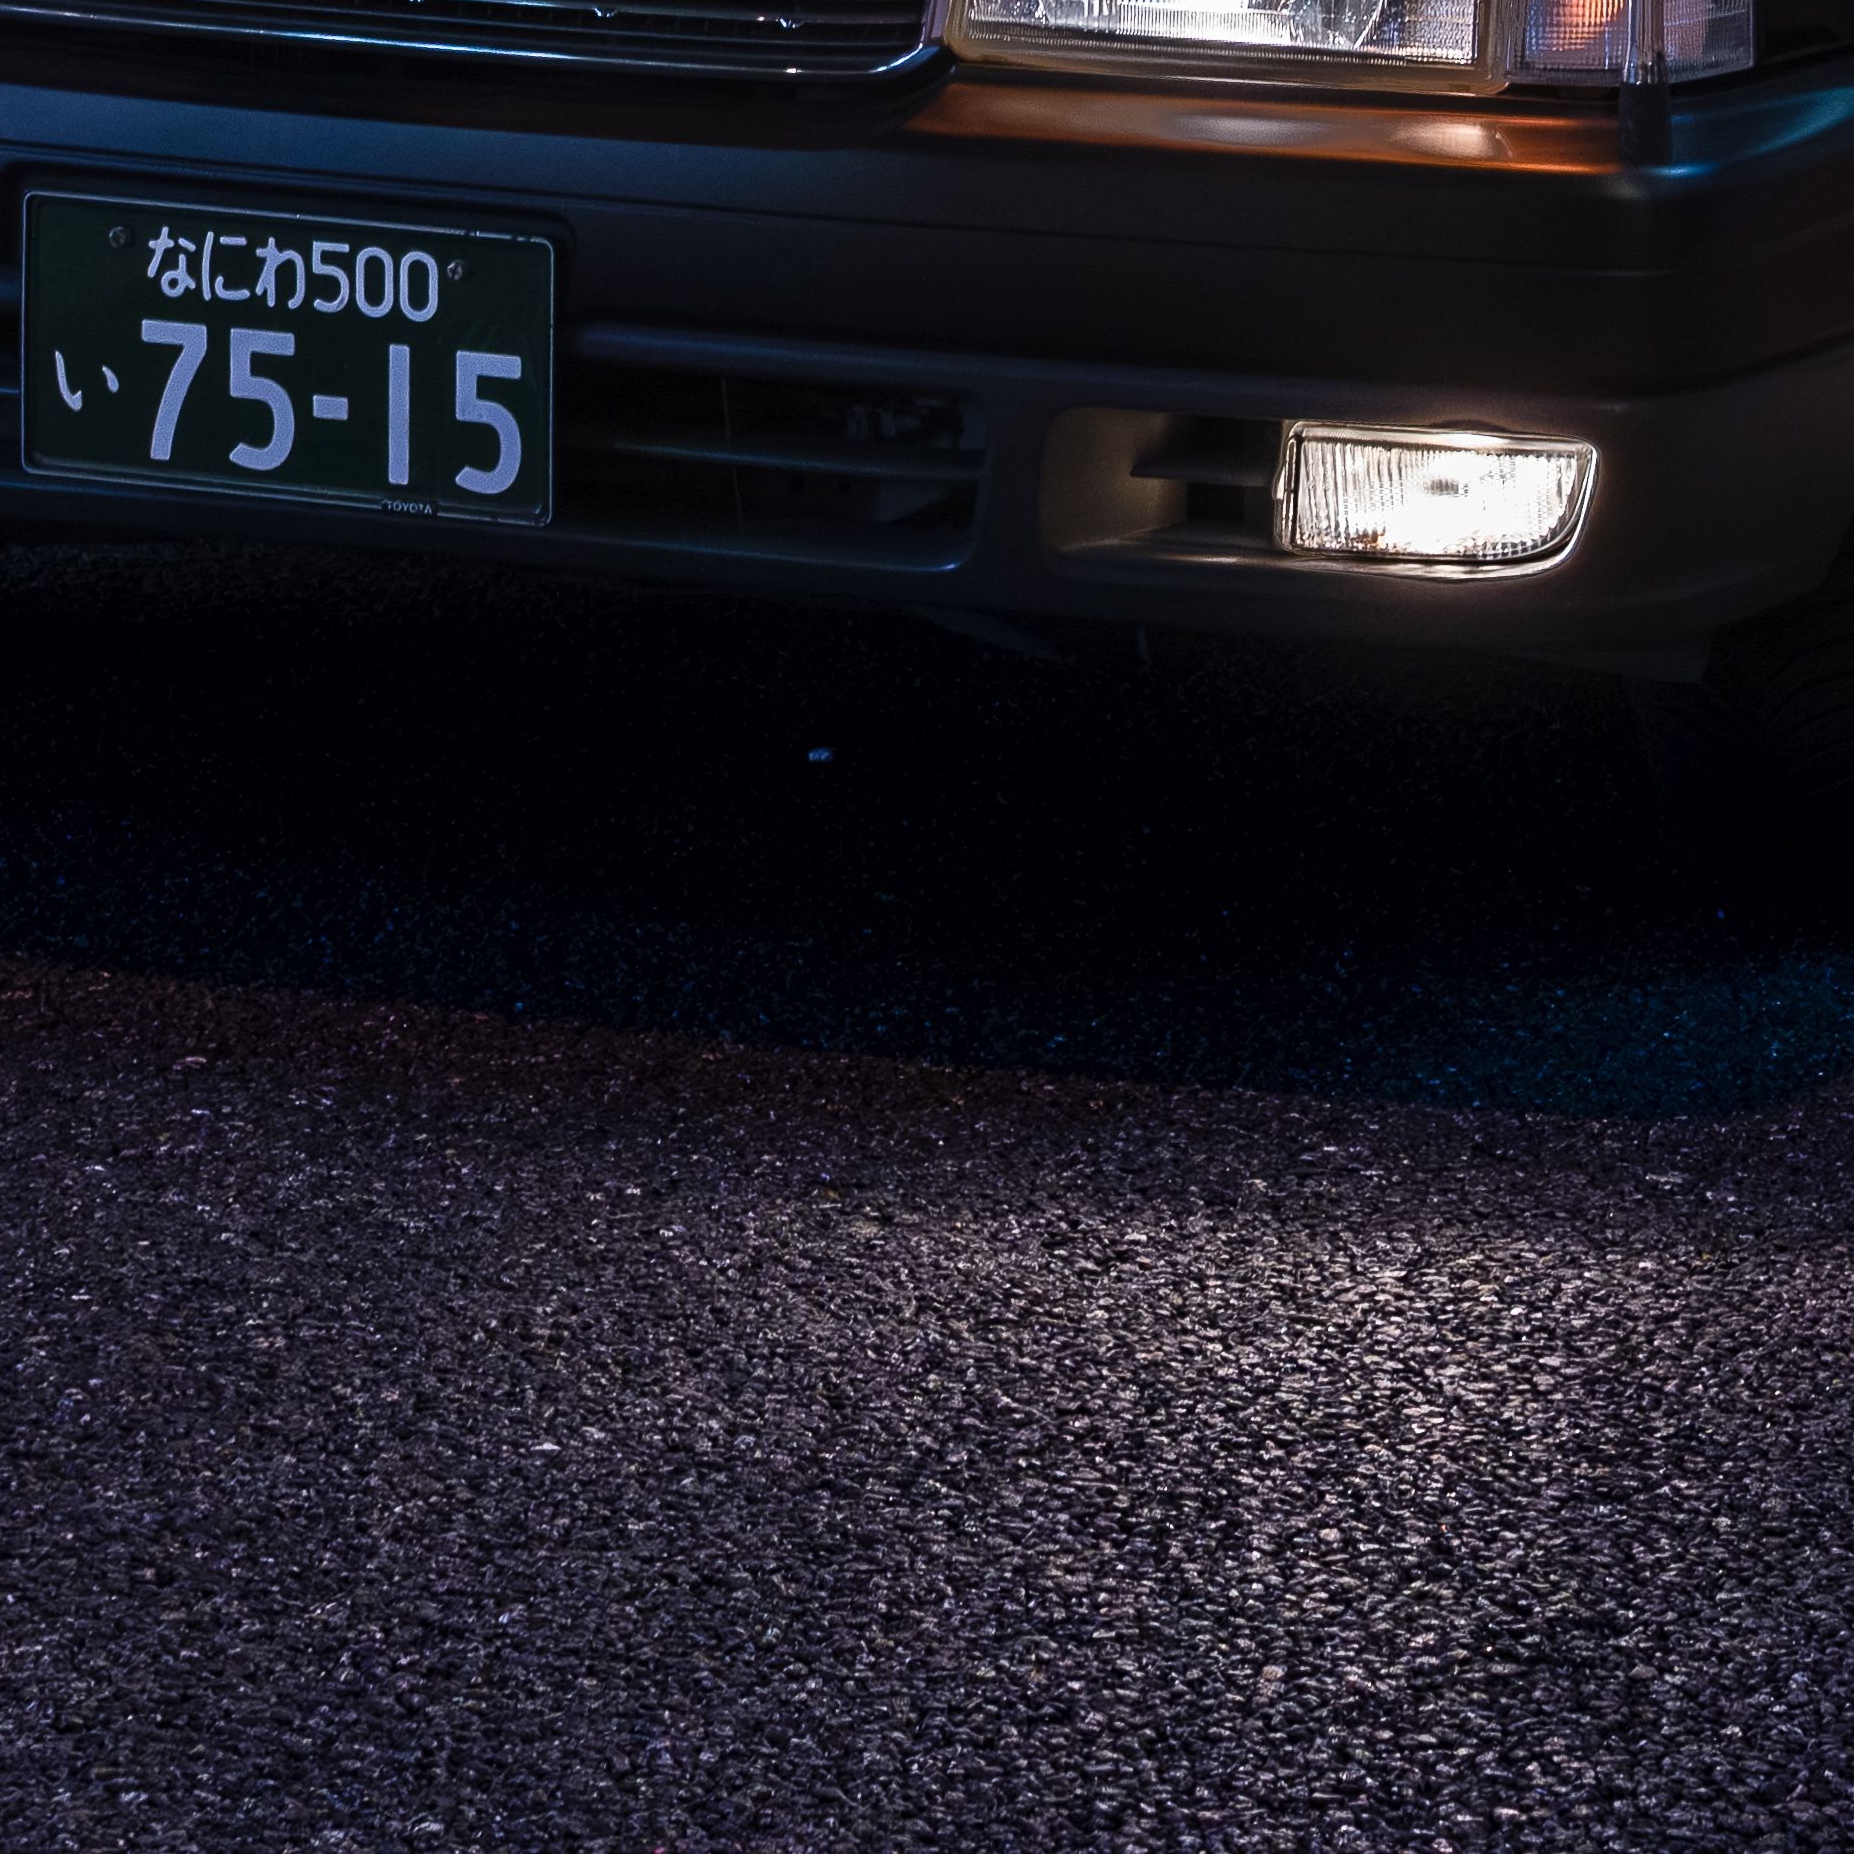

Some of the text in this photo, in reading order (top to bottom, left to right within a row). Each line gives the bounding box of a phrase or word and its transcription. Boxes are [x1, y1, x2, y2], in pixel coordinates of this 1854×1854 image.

[145, 225, 441, 323] なにわ500
[53, 318, 523, 496] い 75-15
[385, 499, 433, 515] TOYOTA
